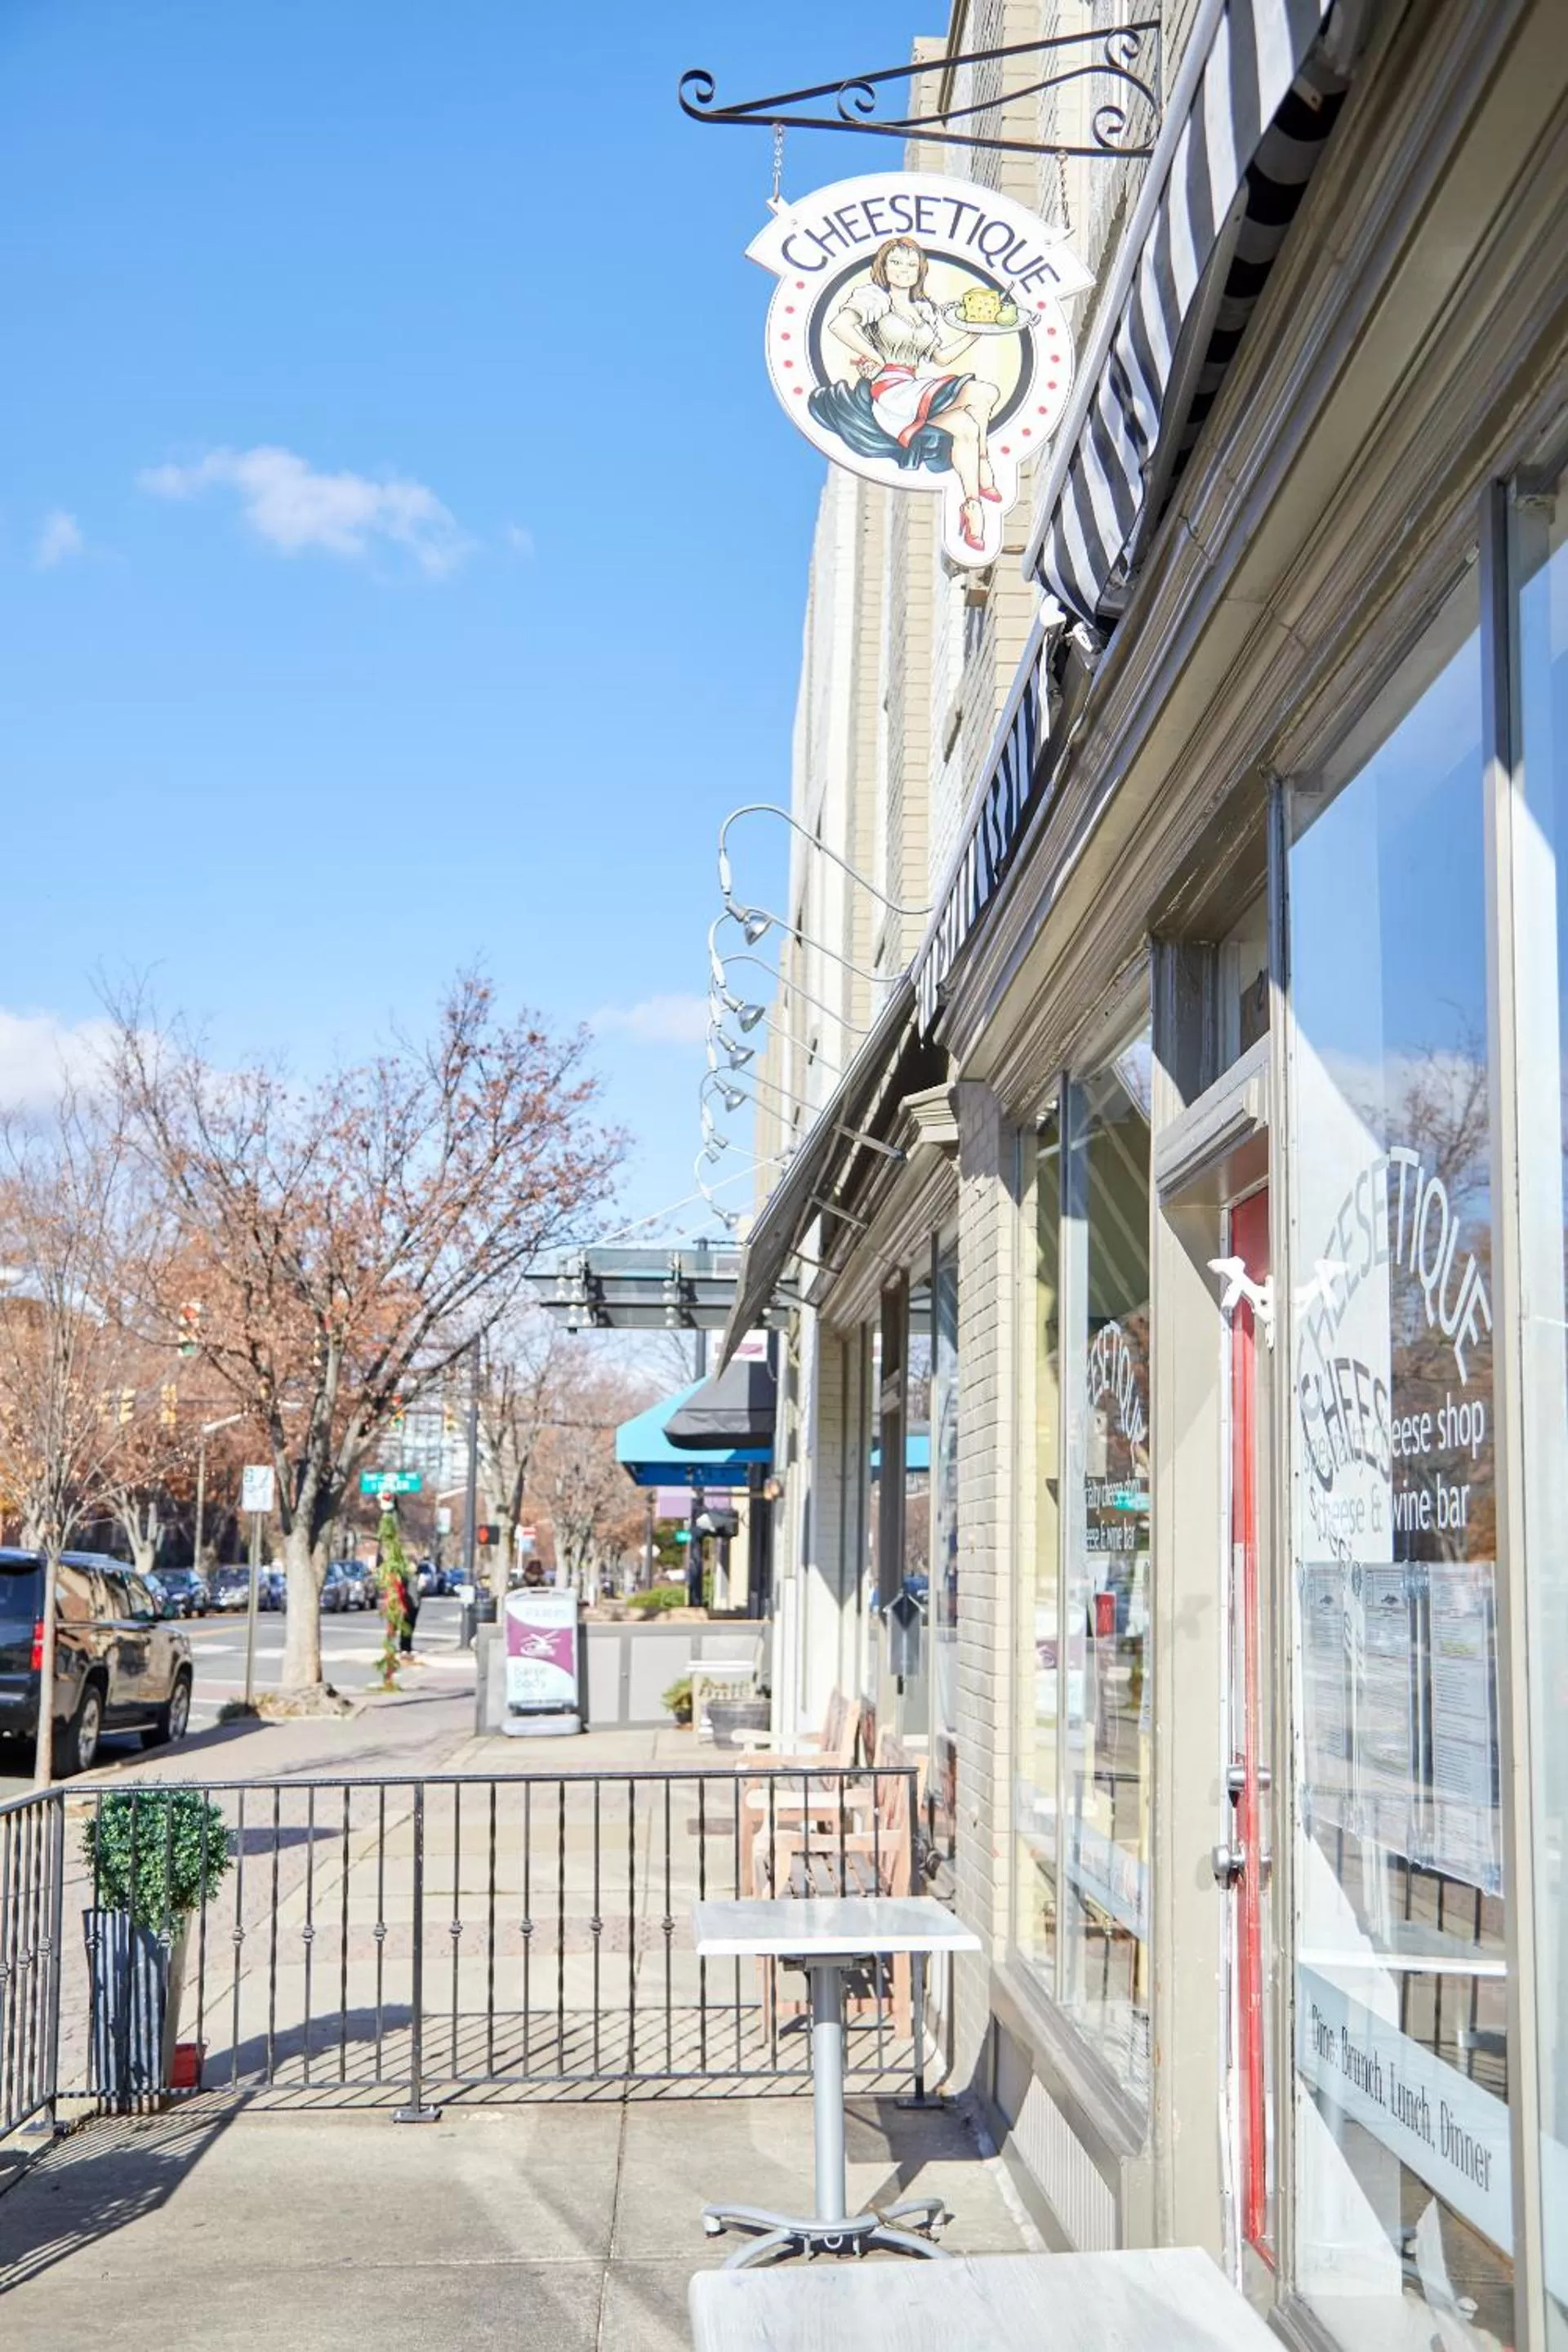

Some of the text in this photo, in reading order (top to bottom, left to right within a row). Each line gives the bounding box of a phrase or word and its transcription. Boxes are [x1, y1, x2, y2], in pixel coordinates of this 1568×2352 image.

[781, 194, 1061, 295] CHEESETIQUE
[1437, 1392, 1485, 1460] shop
[1437, 1472, 1471, 1530] bar
[1389, 2062, 1437, 2154] Lunch,
[1440, 2100, 1492, 2193] Dinner
